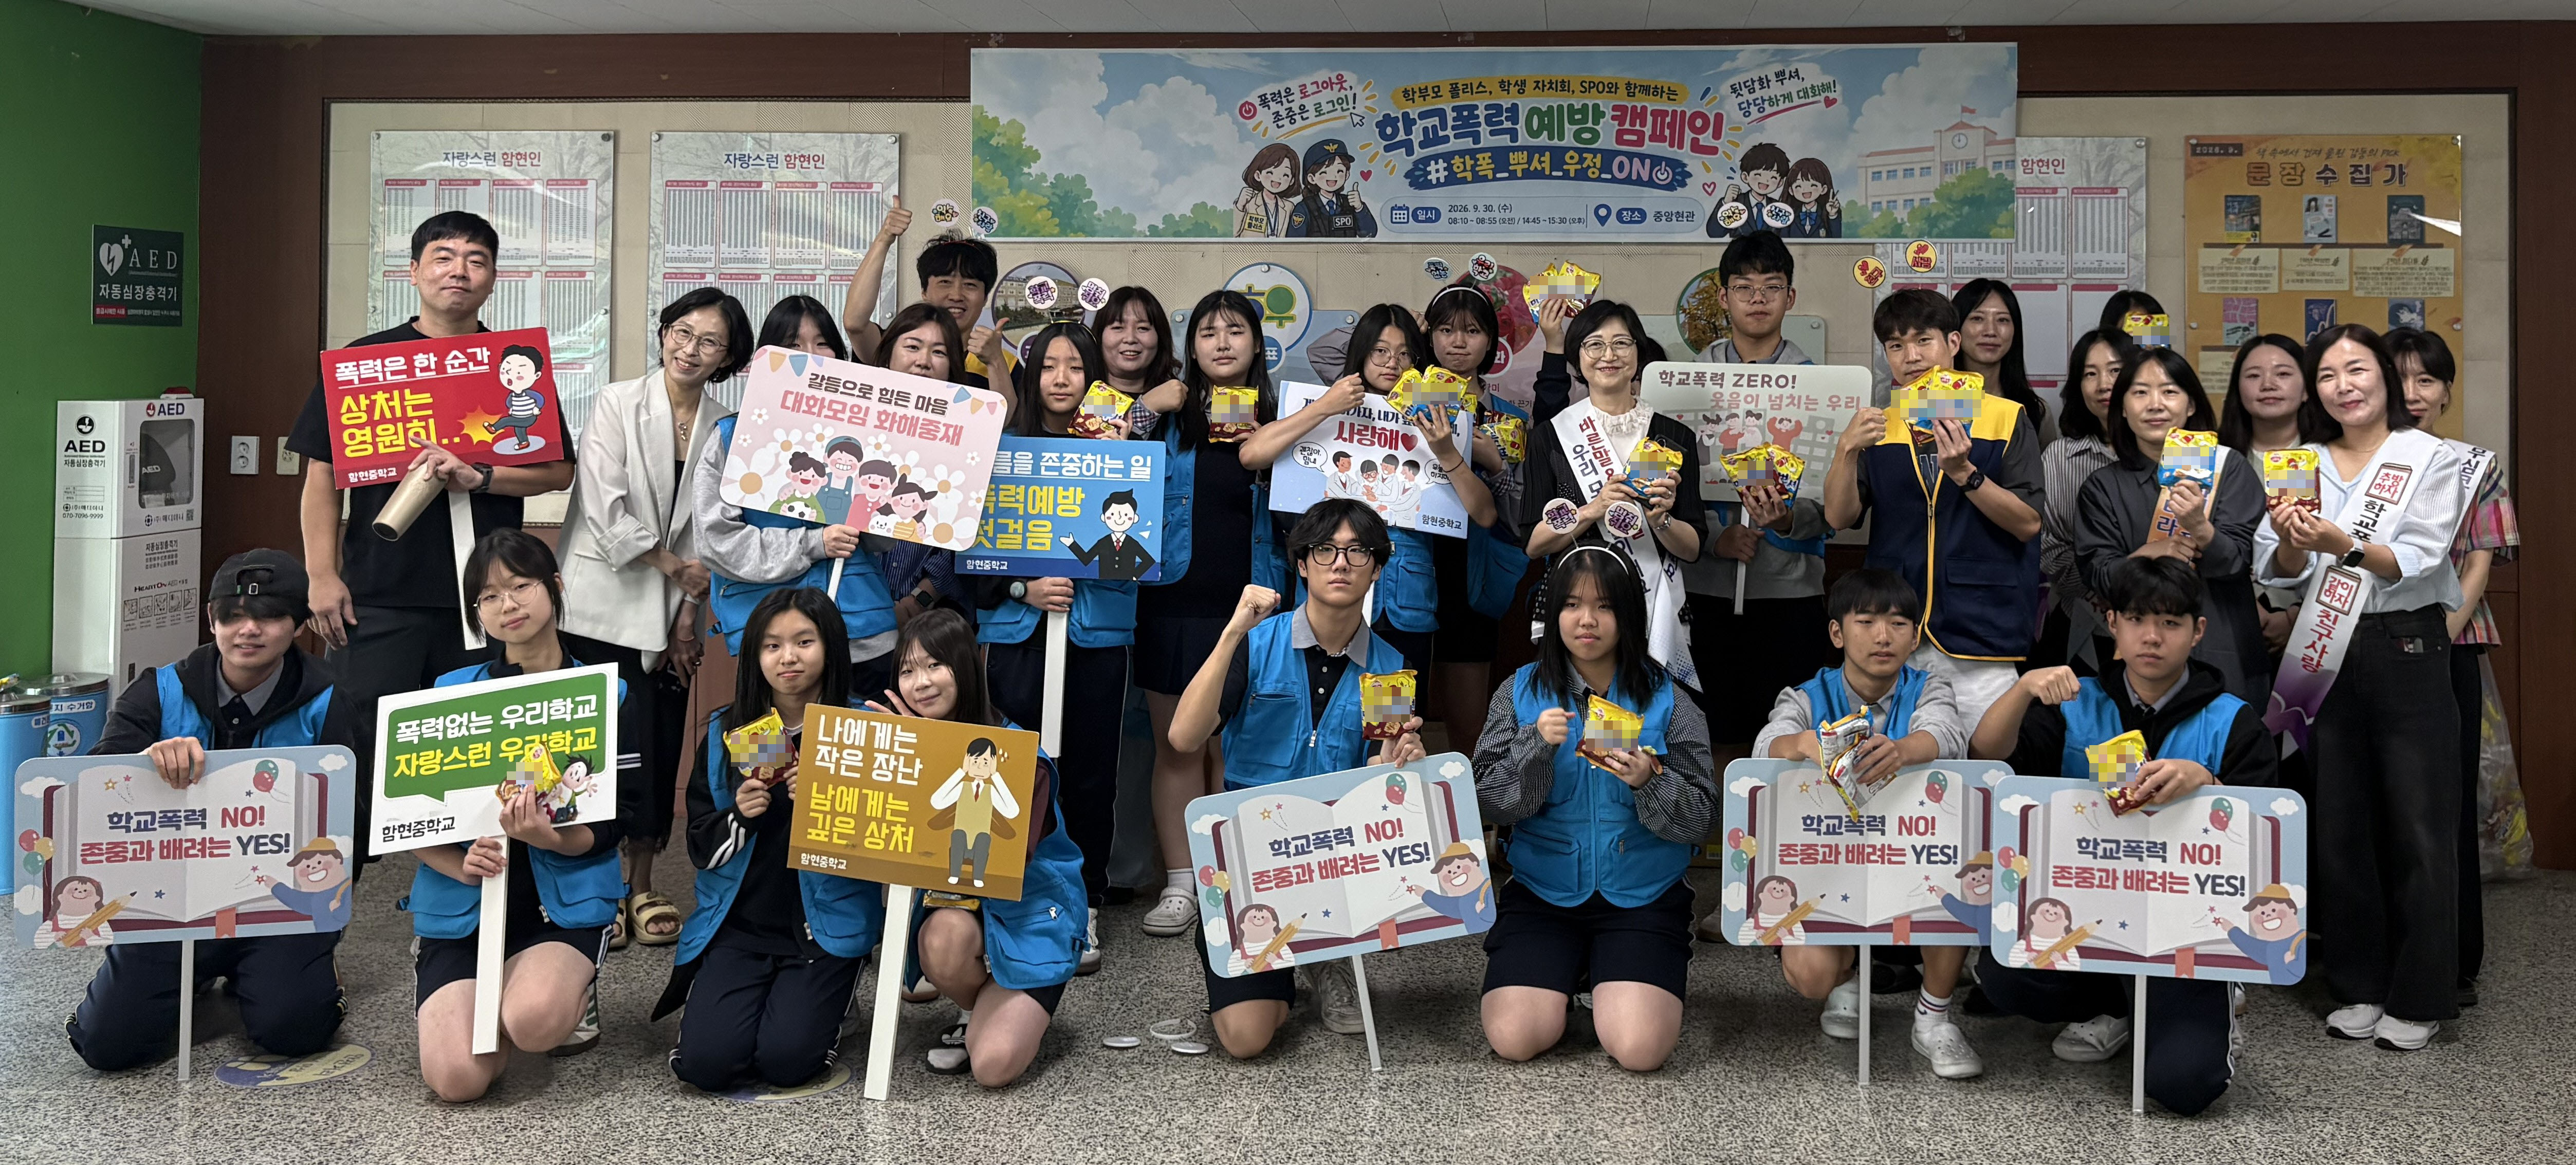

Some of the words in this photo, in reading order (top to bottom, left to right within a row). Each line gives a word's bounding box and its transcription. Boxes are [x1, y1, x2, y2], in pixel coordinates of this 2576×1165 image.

[1775, 68, 1805, 86] 뿌셔,
[1258, 87, 1295, 110] 폭력은
[1299, 73, 1353, 99] 로그아웃,
[1402, 85, 1443, 103] 학부모
[1449, 81, 1493, 99] 폴리스,
[1498, 79, 1527, 95] 학생
[1533, 79, 1575, 95] 자치회,
[1579, 80, 1620, 95] SPO와
[1625, 81, 1679, 102] 함께하는
[1738, 91, 1794, 118] 당당하게
[1797, 80, 1837, 100] 대화해!
[1272, 104, 1309, 129] 존중은
[1313, 93, 1357, 118] 로그인!
[1375, 102, 1519, 157] 학교폭력
[1525, 103, 1606, 145] 예방
[1611, 104, 1724, 156] 캠페인
[443, 151, 496, 168] 자랑스런
[501, 151, 541, 167] 함현인
[724, 153, 779, 170] 자랑스런
[784, 154, 825, 169] 함현인
[2021, 158, 2065, 175] 함현인
[1417, 210, 1435, 220] 일시
[1448, 205, 1470, 213] 2026.
[1473, 205, 1480, 213] 9.
[1482, 205, 1495, 213] 30.
[1498, 204, 1512, 214] (수)
[1448, 217, 1468, 225] 08:10
[1476, 217, 1497, 225] 08:55
[1499, 217, 1516, 225] (오전)
[1522, 216, 1541, 225] 14:45
[1569, 217, 1585, 225] (오후)
[1622, 210, 1641, 221] 장소
[1653, 211, 1696, 222] 중앙현관
[1335, 217, 1352, 226] SPO
[129, 248, 177, 269] AED
[99, 283, 177, 302] 자동심장충격기
[335, 356, 408, 385] 폭력은
[413, 353, 437, 378] 한
[445, 347, 490, 373] 순간
[1659, 369, 1725, 389] 학교폭력
[1733, 373, 1797, 389] ZERO!
[807, 373, 874, 400] 갈등으로
[878, 387, 912, 409] 힘든
[915, 395, 949, 416] 마음
[1710, 391, 1760, 410] 웃음이
[1768, 394, 1819, 412] 넘치는
[1827, 395, 1861, 412] 우리
[157, 403, 185, 416] AED
[340, 388, 433, 426] 상처는
[780, 389, 871, 427] 대화모임
[874, 410, 964, 447] 화해중재
[1378, 409, 1400, 423] 내가
[64, 440, 105, 453] AED
[1333, 421, 1400, 451] 사랑해
[64, 459, 105, 468] 자동심장충격기
[142, 465, 161, 474] AED
[1040, 452, 1125, 478] 존중하는
[1130, 455, 1151, 479] 일
[1573, 445, 1598, 477] 우리
[348, 467, 397, 483] 함현중학교
[2379, 472, 2404, 487] 추방
[2374, 482, 2398, 498] 하자
[1422, 514, 1462, 529] 함현중학교
[966, 560, 1008, 570] 함현중학교
[2324, 587, 2348, 609] 하자
[2327, 575, 2353, 599] 같이
[396, 711, 493, 744] 폭력없는
[500, 694, 598, 730] 우리학교
[817, 714, 918, 754] 나에게는
[394, 742, 491, 778] 자랑스런
[815, 745, 864, 778] 작은
[871, 752, 923, 786] 장난
[809, 782, 910, 822] 남에게는
[107, 807, 207, 834] 학교폭력
[221, 805, 265, 828] NO!
[382, 816, 455, 842] 함현중학교
[1801, 814, 1886, 837] 학교폭력
[1898, 816, 1936, 837] NO!
[806, 811, 855, 845] 깊은
[863, 822, 914, 854] 상처
[1268, 826, 1355, 859] 학교폭력
[1365, 818, 1404, 843] NO!
[80, 840, 154, 865] 존중과
[159, 837, 231, 861] 배려는
[236, 833, 291, 856] YES!
[1778, 843, 1842, 865] 존중과
[1845, 843, 1907, 865] 배려는
[1910, 844, 1958, 865] YES!
[2076, 837, 2167, 863] 학교폭력
[2180, 842, 2221, 865] NO!
[801, 853, 847, 870] 함현중학교
[1252, 861, 1315, 893] 존중과
[1319, 853, 1380, 880] 배려는
[1382, 841, 1431, 868] YES!
[2051, 865, 2119, 892] 존중과
[2123, 868, 2190, 895] 배려는
[2194, 873, 2246, 897] YES!
